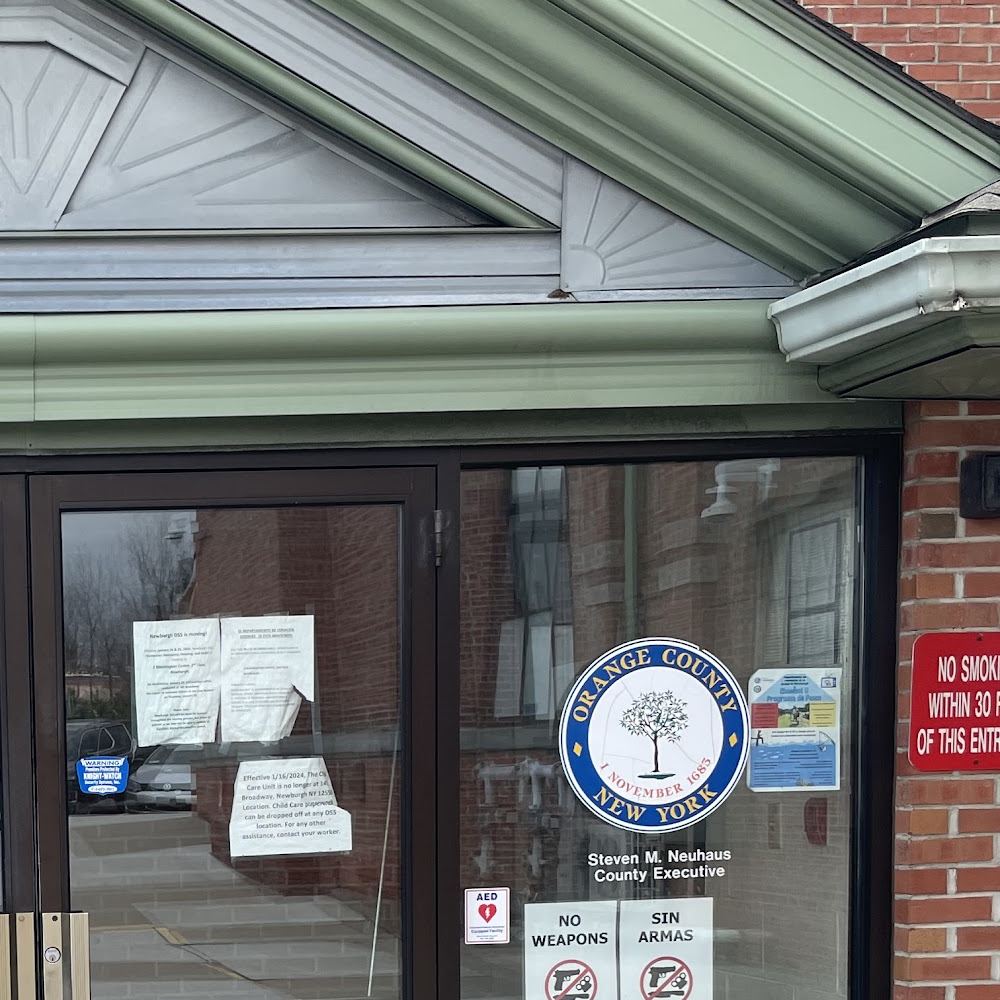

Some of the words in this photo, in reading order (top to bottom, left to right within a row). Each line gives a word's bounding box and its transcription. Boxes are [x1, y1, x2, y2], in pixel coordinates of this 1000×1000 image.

[938, 656, 957, 682] NO
[573, 648, 651, 722] ORANGE
[662, 648, 738, 713] COUNTY
[928, 692, 971, 718] WITHIN
[975, 691, 991, 717] 30
[917, 729, 934, 755] OF
[938, 728, 966, 754] THIS
[607, 772, 683, 798] NOVEMBER
[687, 757, 711, 786] 1685
[593, 786, 647, 822] NEW
[656, 786, 718, 823] YORK
[588, 852, 639, 866] Steven
[645, 851, 662, 864] M.
[668, 849, 731, 863] Neuhaus
[594, 866, 647, 883] County
[653, 865, 725, 880] Executive
[476, 893, 498, 901] AED
[559, 915, 581, 927] NO
[652, 912, 680, 925] SIN
[532, 932, 608, 947] WEAPONS
[638, 929, 693, 944] ARMAS
